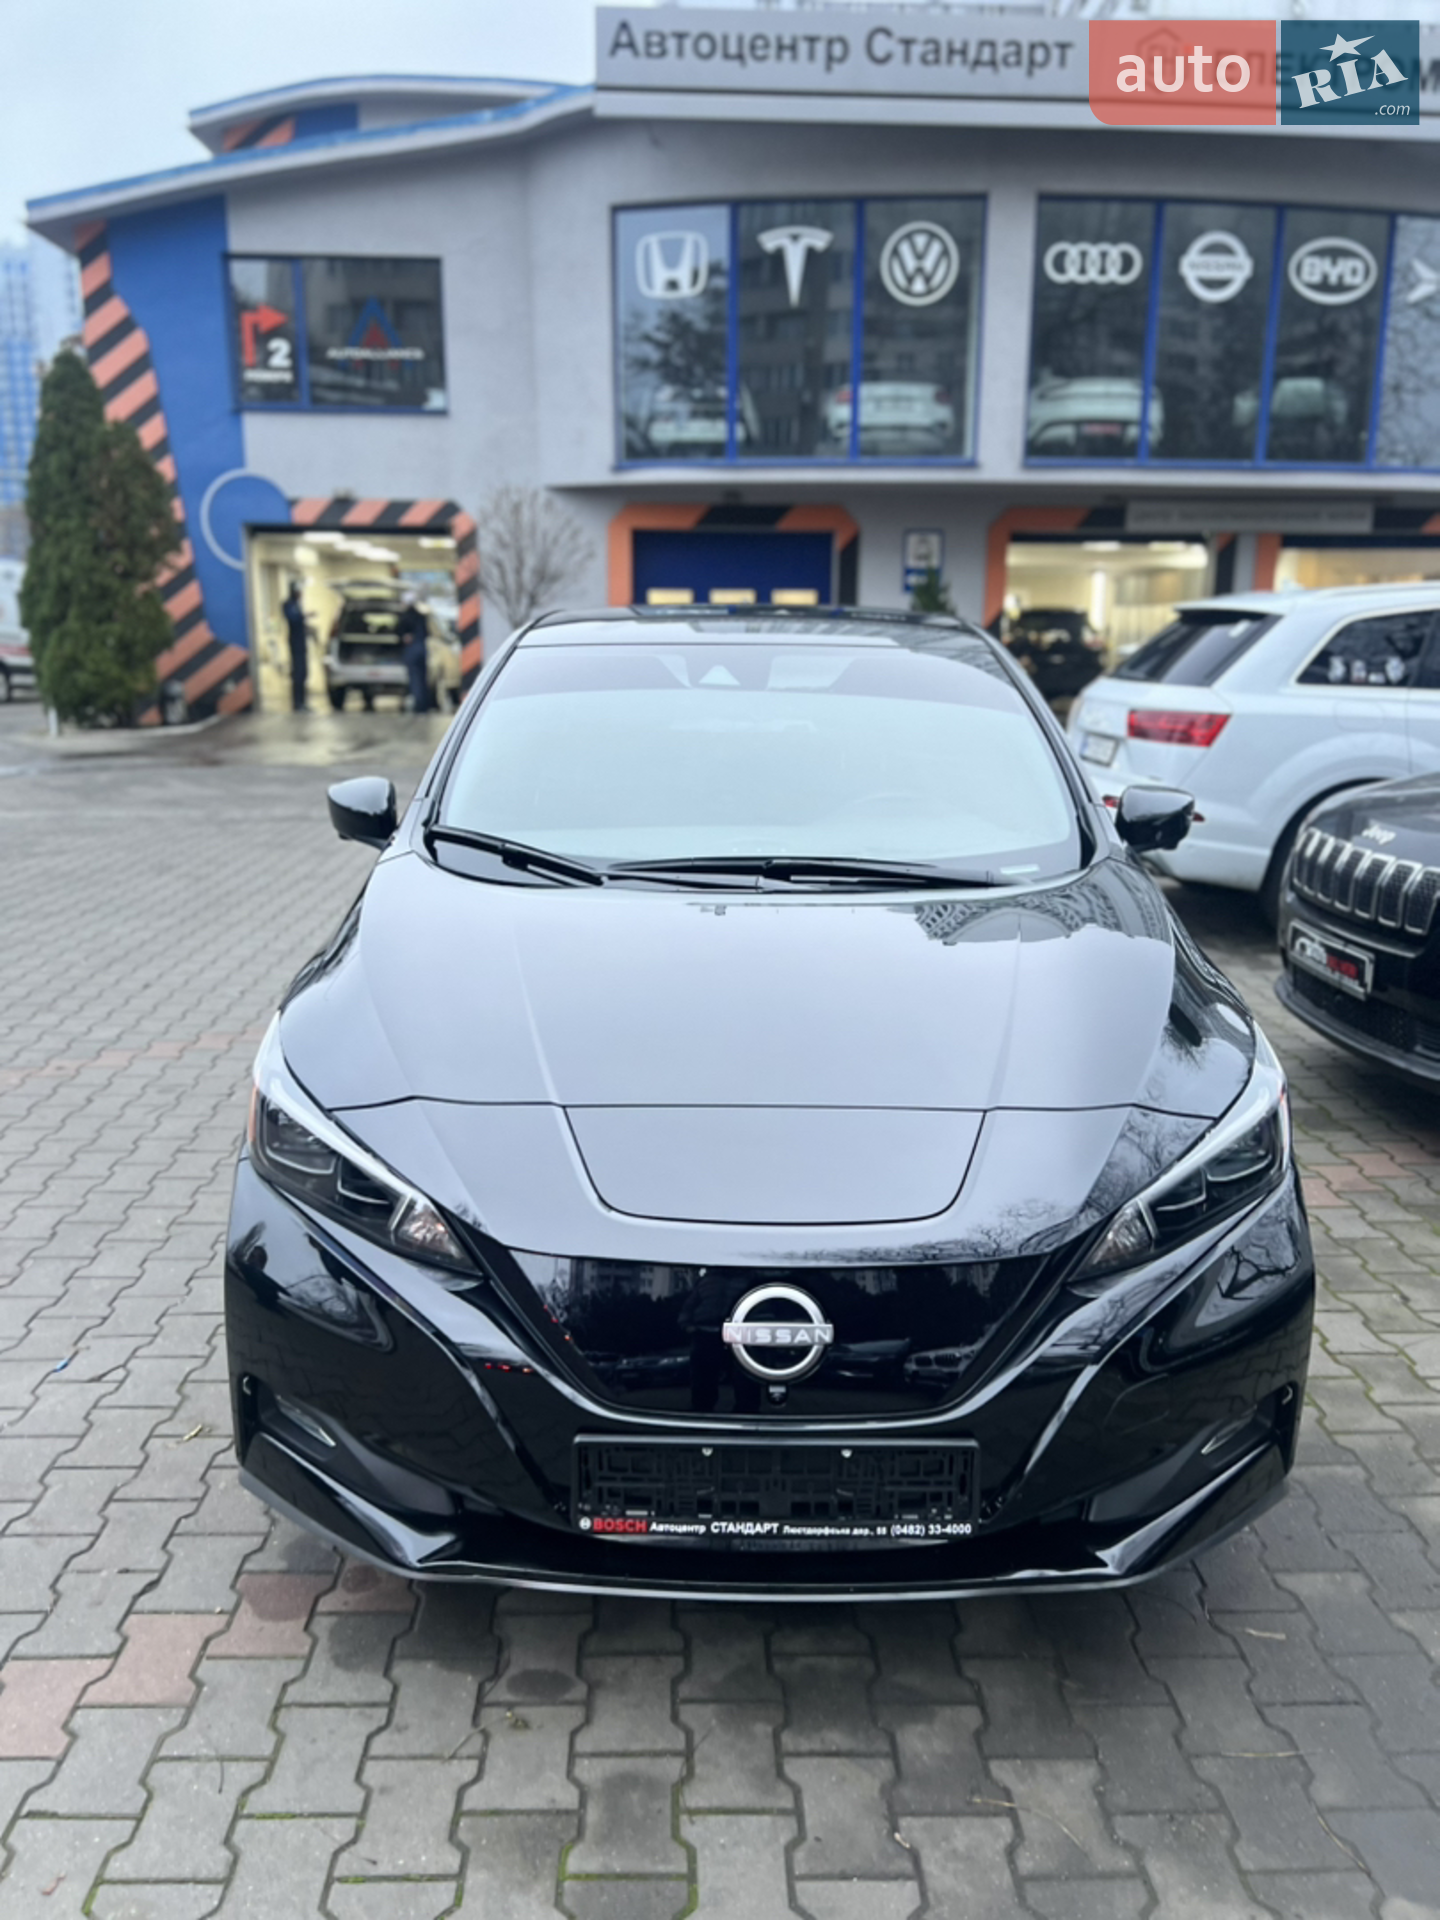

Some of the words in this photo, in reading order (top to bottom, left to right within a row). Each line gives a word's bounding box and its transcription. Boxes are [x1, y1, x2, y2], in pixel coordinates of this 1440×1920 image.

[609, 19, 850, 73] Автоцентр
[864, 26, 1075, 78] Стандарт
[1301, 256, 1367, 286] BYD
[267, 337, 293, 369] 2
[1361, 824, 1397, 846] Jeep
[726, 1326, 831, 1344] NISSAN
[593, 1518, 647, 1532] BOSCH
[650, 1521, 706, 1535] Автоцентр
[710, 1521, 779, 1535] СТАНДАРТ
[890, 1523, 926, 1537] (0482)
[928, 1522, 972, 1535] 33-4000
